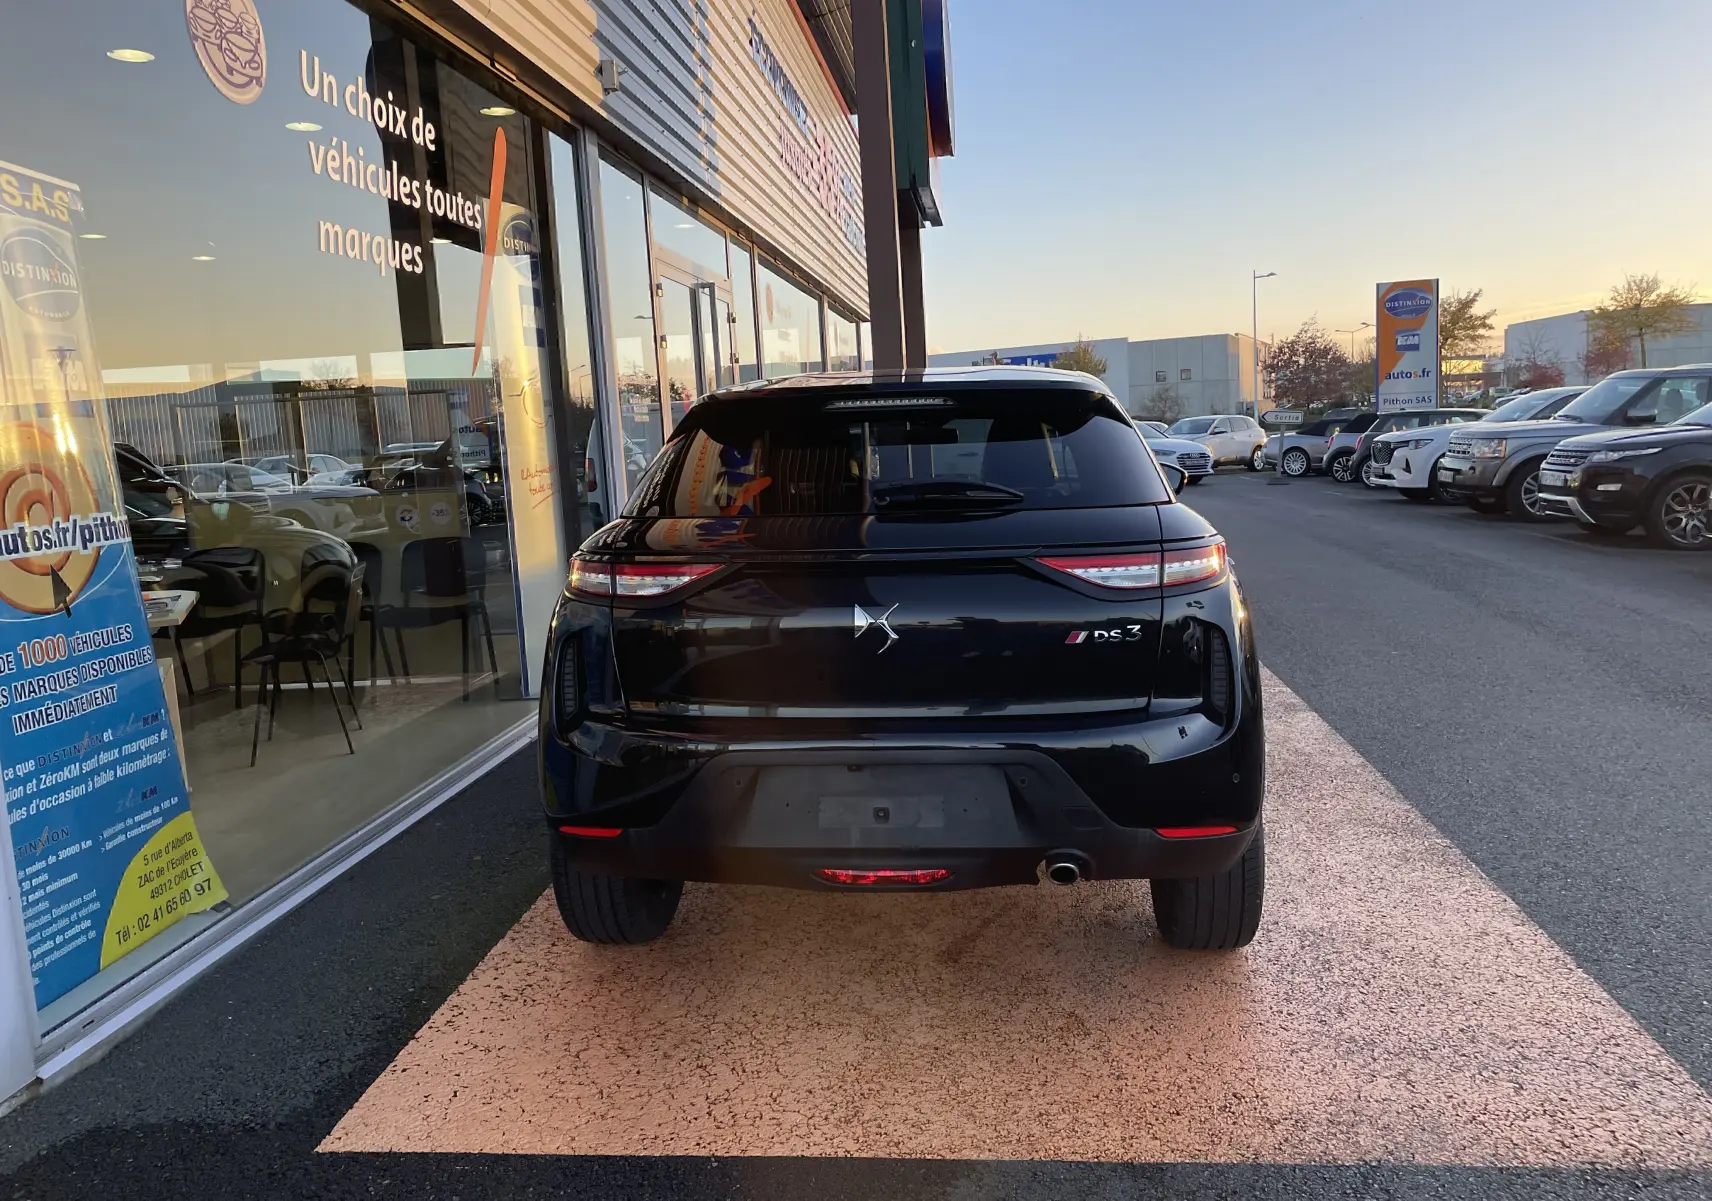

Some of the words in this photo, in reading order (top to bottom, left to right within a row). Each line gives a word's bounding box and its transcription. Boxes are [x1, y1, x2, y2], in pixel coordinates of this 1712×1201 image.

[301, 50, 338, 107] Un
[344, 76, 407, 138] choix
[412, 107, 436, 151] de
[308, 137, 421, 209] véhicules
[425, 179, 482, 229] toutes
[319, 220, 424, 277] marques
[1384, 368, 1431, 380] autos.fr
[1383, 397, 1413, 405] Pithon
[1415, 396, 1432, 404] SAS
[18, 634, 67, 668] 1000
[69, 624, 132, 655] VÉHICULES
[12, 667, 79, 702] MARQUES
[80, 646, 152, 682] DISPONIBLES
[12, 684, 117, 735] IMMÉDIATEMENT
[4, 768, 14, 781] ce
[16, 760, 35, 777] que
[103, 728, 113, 742] et
[26, 778, 37, 794] et
[40, 762, 79, 789] ZéroKM
[82, 755, 98, 774] sont
[99, 748, 119, 766] deux
[122, 734, 159, 756] marques
[160, 728, 168, 741] de
[30, 784, 85, 815] d'occasion
[88, 778, 93, 792] à
[94, 769, 114, 789] faible
[25, 860, 47, 875] moins
[47, 855, 57, 865] de
[57, 843, 81, 860] 30000
[81, 839, 93, 850] Km
[143, 854, 150, 866] 5
[151, 849, 163, 863] rue
[164, 831, 193, 855] d'Alberta
[28, 888, 45, 903] mois
[46, 872, 78, 894] minimum
[32, 872, 49, 886] mois
[83, 888, 97, 901] sont
[137, 870, 155, 888] ZAC
[155, 866, 165, 879] de
[150, 880, 173, 900] 49312
[174, 861, 204, 886] CHOLET
[71, 912, 78, 922] et
[115, 925, 131, 946] Tél
[137, 913, 151, 931] 02
[153, 905, 164, 922] 41
[166, 896, 179, 914] 65
[179, 888, 192, 906] 60
[194, 877, 212, 896] 97
[88, 929, 97, 940] de
